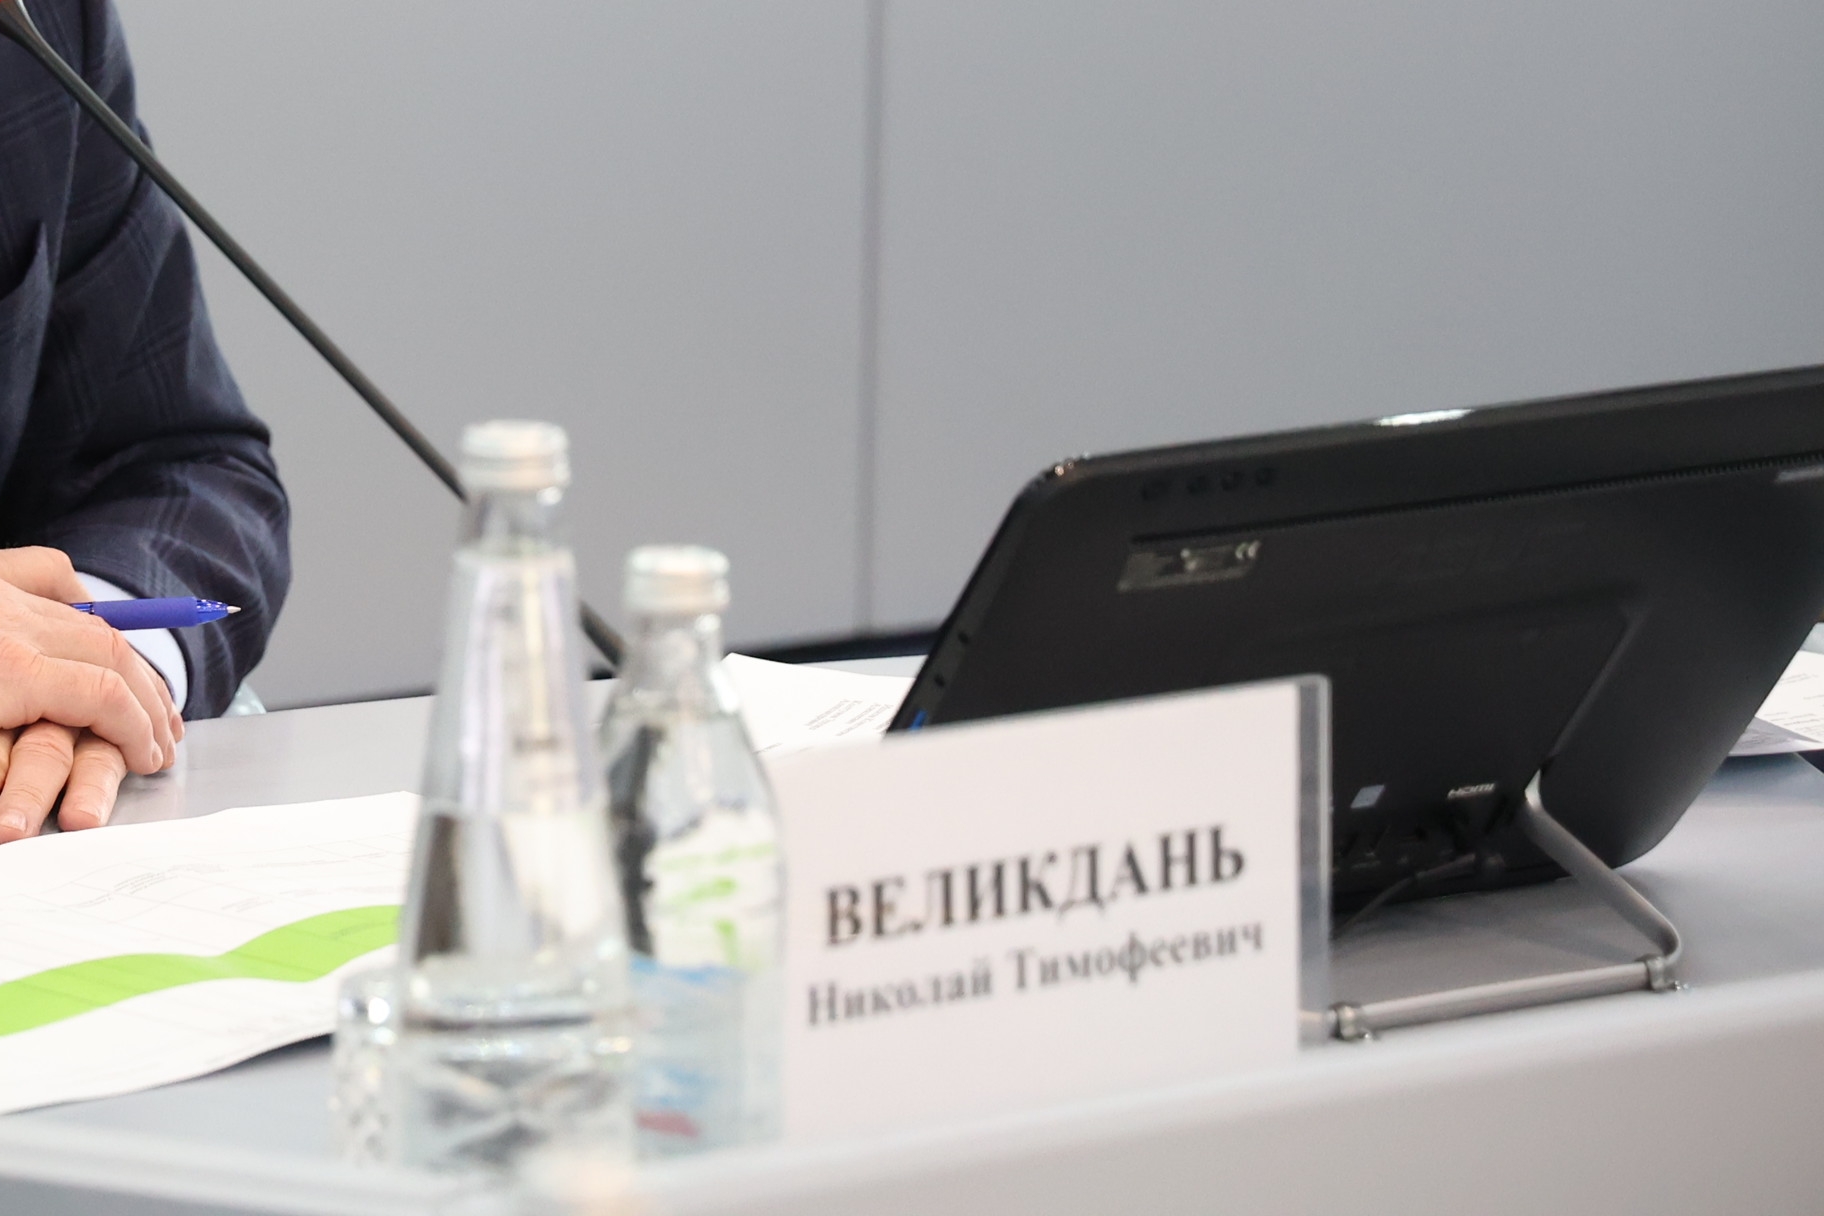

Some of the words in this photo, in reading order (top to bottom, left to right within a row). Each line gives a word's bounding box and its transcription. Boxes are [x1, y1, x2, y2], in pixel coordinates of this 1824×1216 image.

[825, 824, 1246, 948] ВЕЛИКДАНЬ
[806, 961, 993, 1026] Николай
[1007, 922, 1264, 990] Тимофеевич
